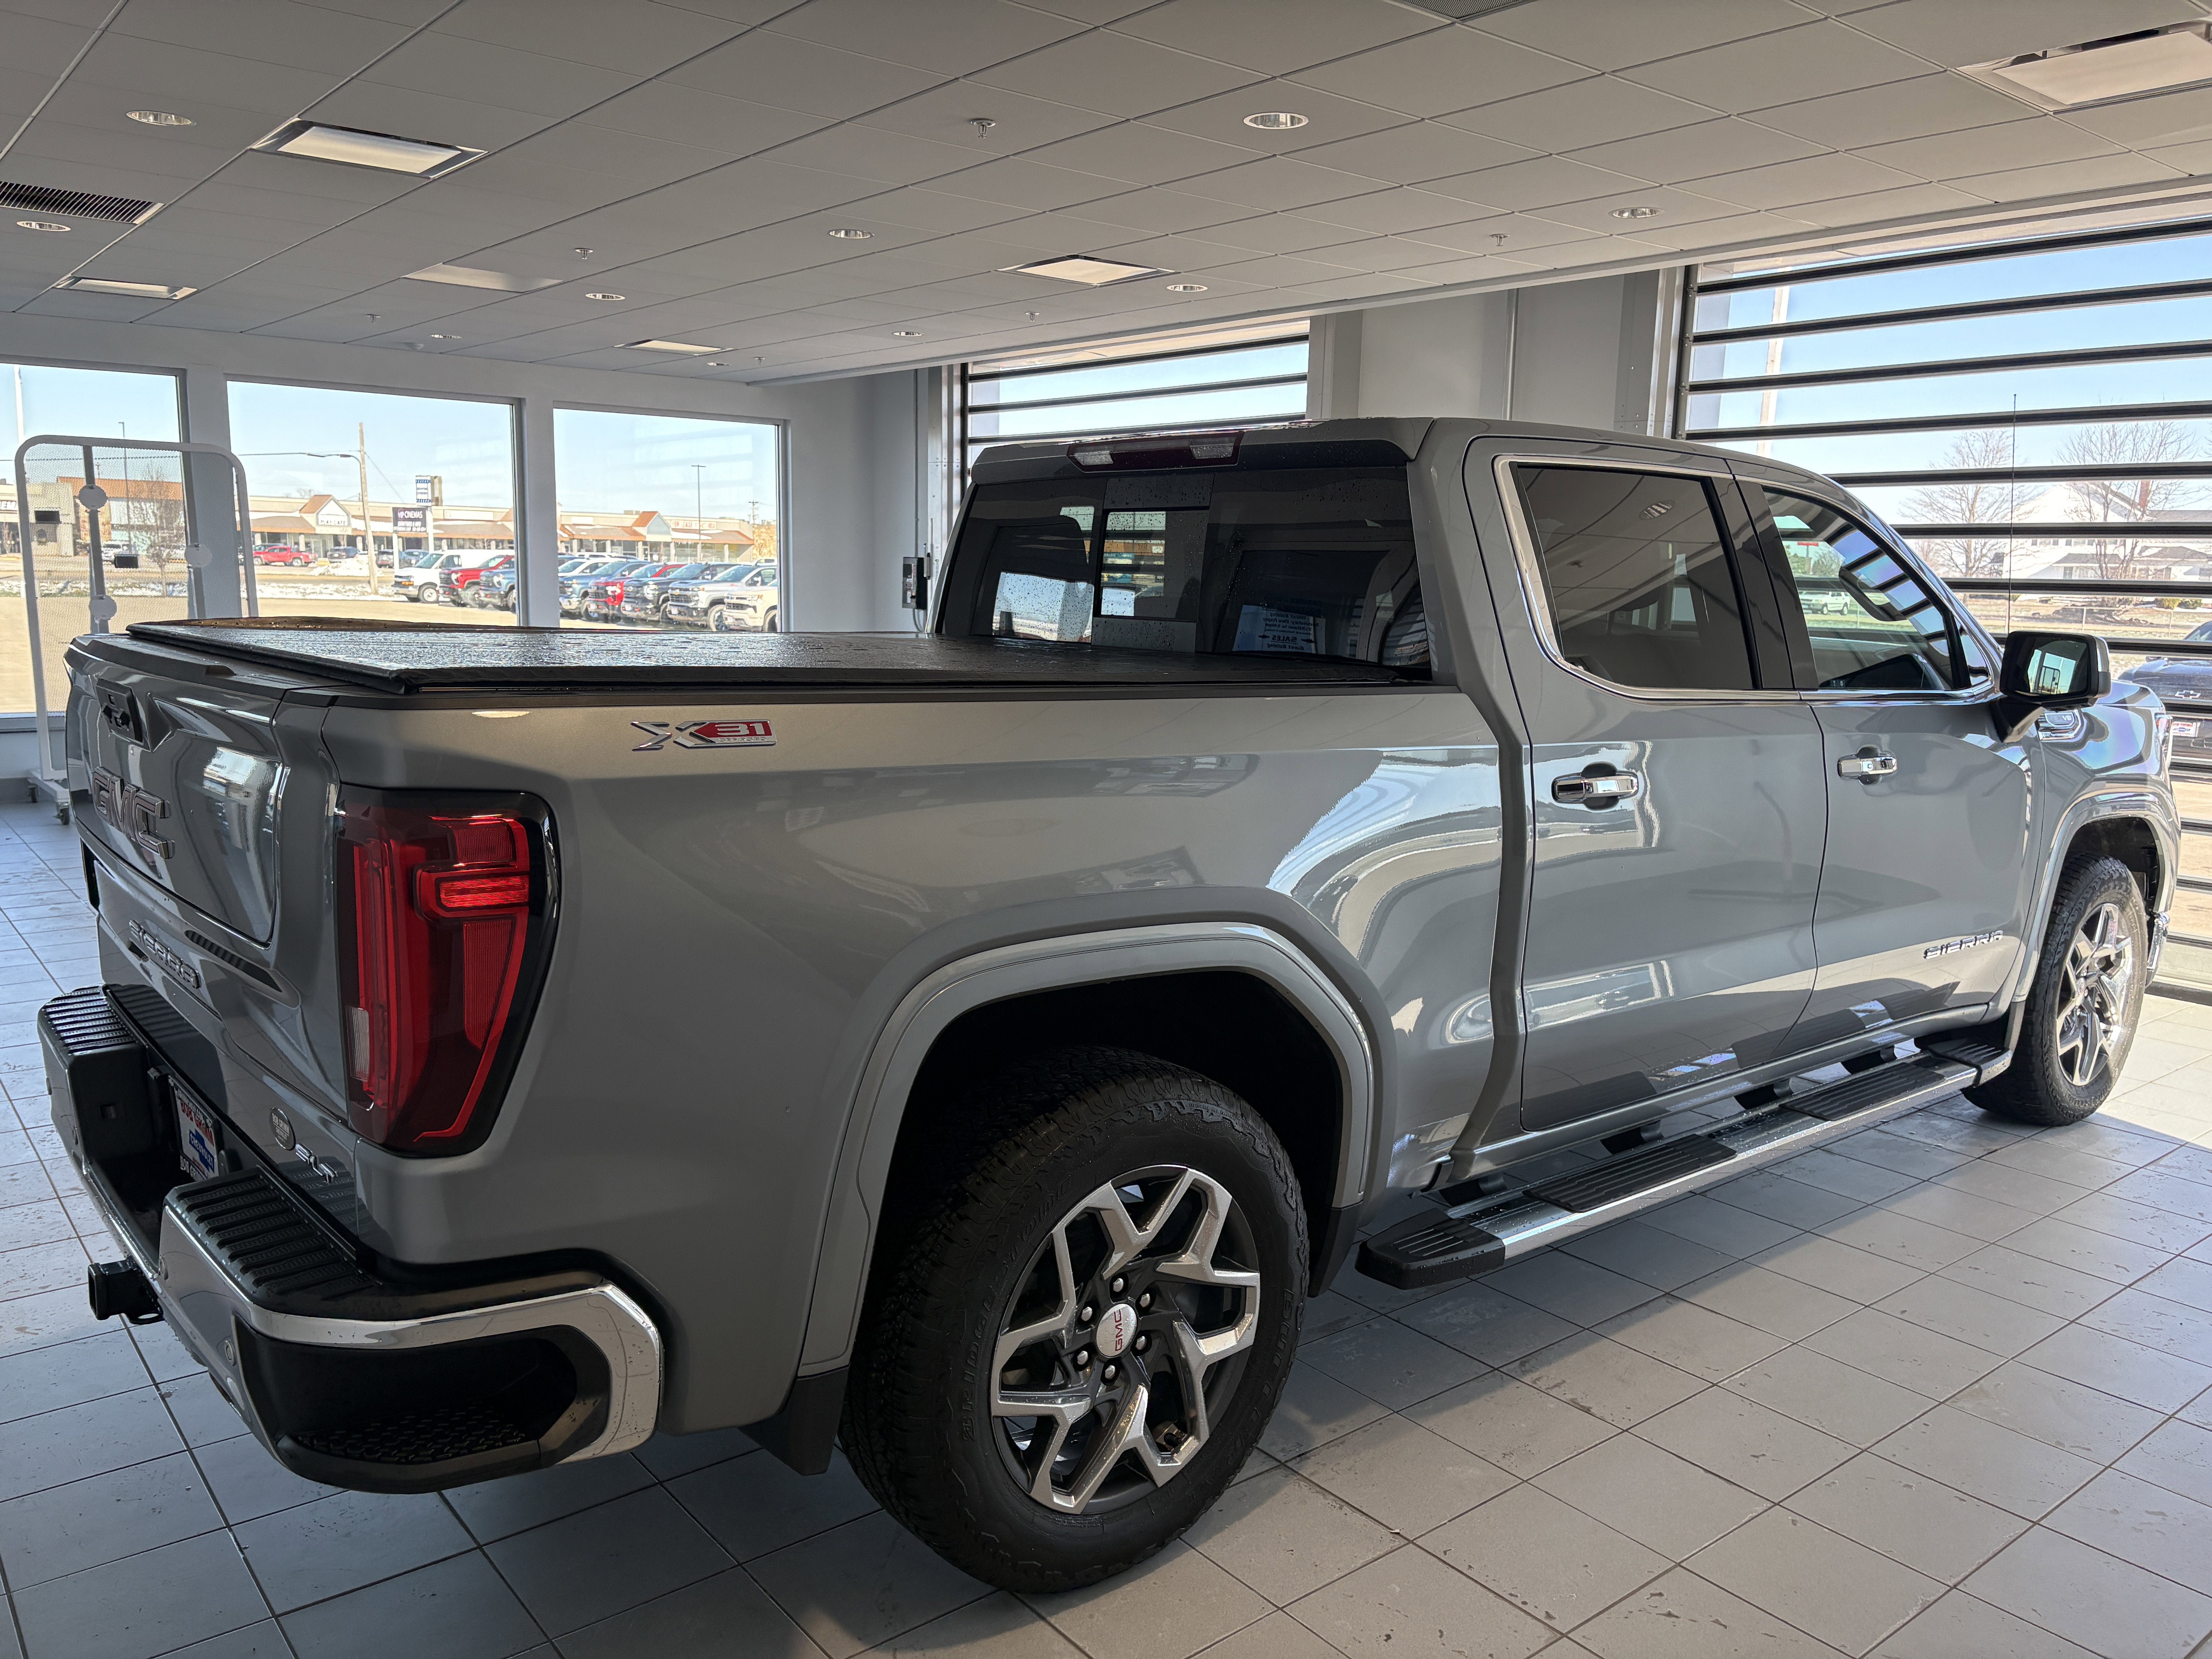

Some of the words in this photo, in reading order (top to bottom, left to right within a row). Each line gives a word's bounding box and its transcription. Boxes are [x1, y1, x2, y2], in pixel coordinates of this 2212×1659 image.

[93, 766, 170, 859] GMC
[129, 920, 201, 989] SIERRA
[1923, 930, 2003, 959] SIERRA
[190, 1133, 213, 1169] CHEVROLET
[295, 1144, 338, 1183] SLT
[1114, 1309, 1123, 1351] GMC
